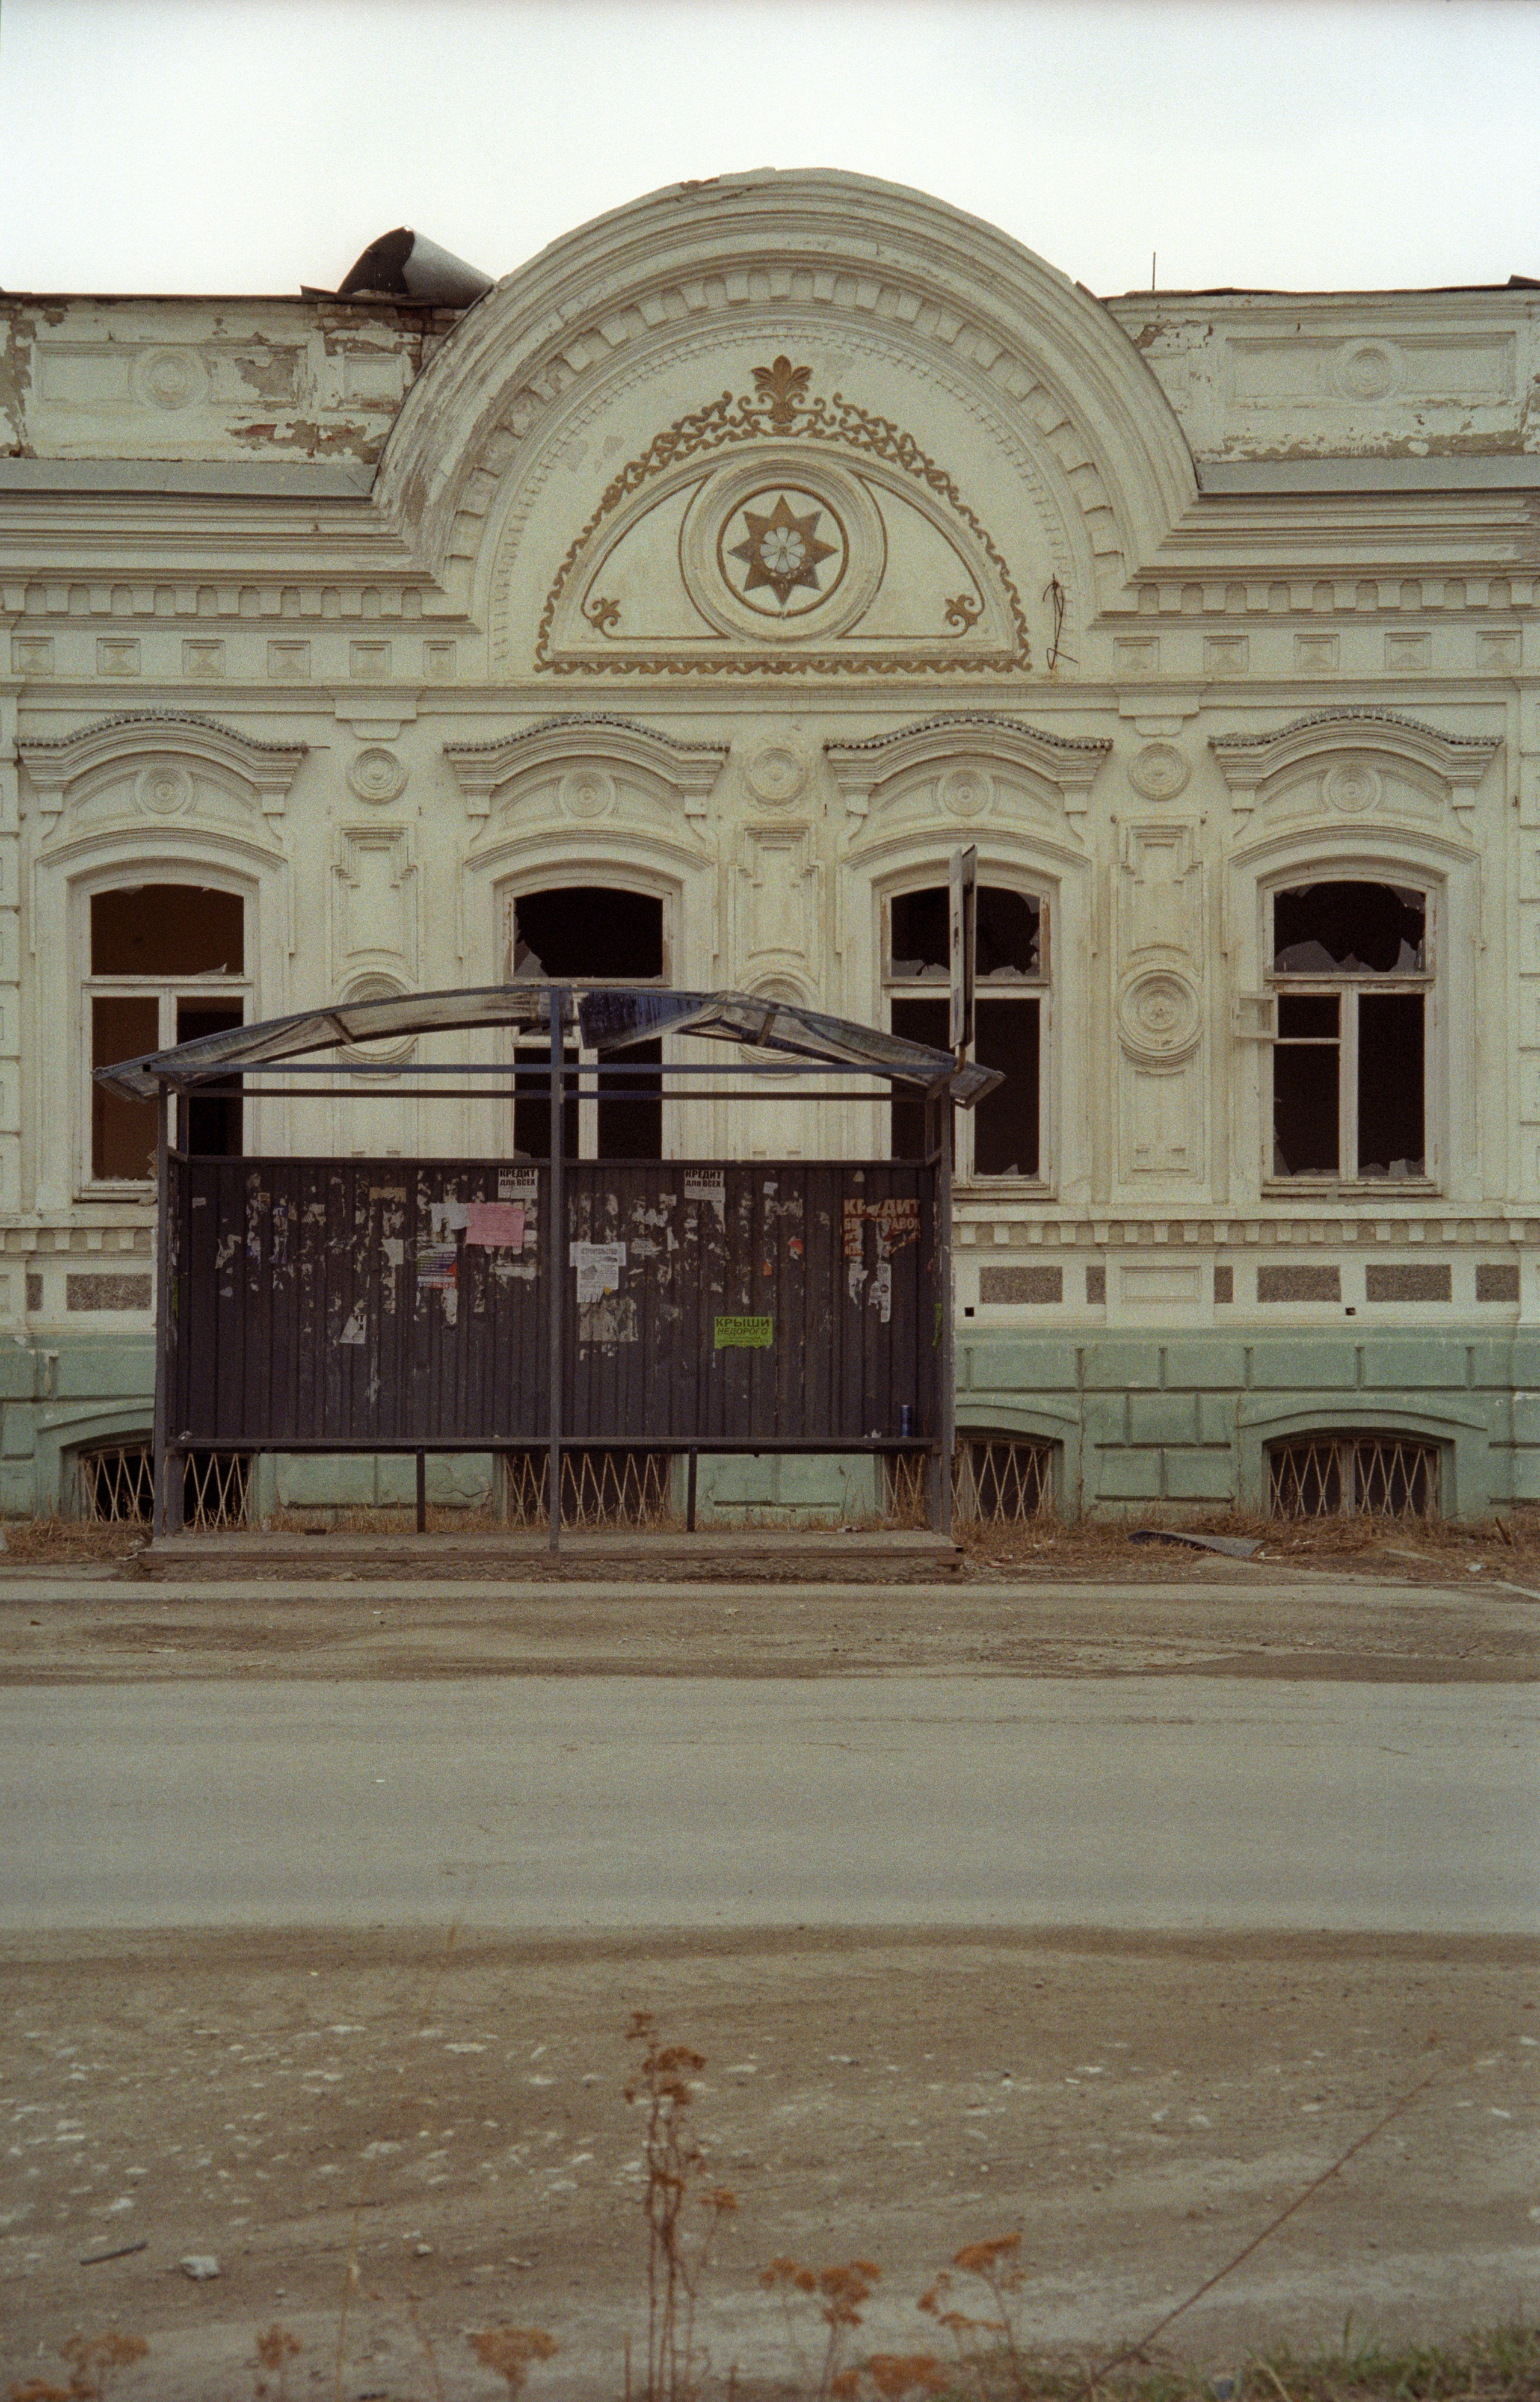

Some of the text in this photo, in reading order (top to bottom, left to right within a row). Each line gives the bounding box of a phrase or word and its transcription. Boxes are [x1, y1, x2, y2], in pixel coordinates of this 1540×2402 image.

[499, 1169, 535, 1178] КРЕДИТ
[685, 1170, 722, 1179] КРЕДИТ
[843, 1199, 920, 1217] КРДИТ
[715, 1318, 770, 1327] КРЫШИ
